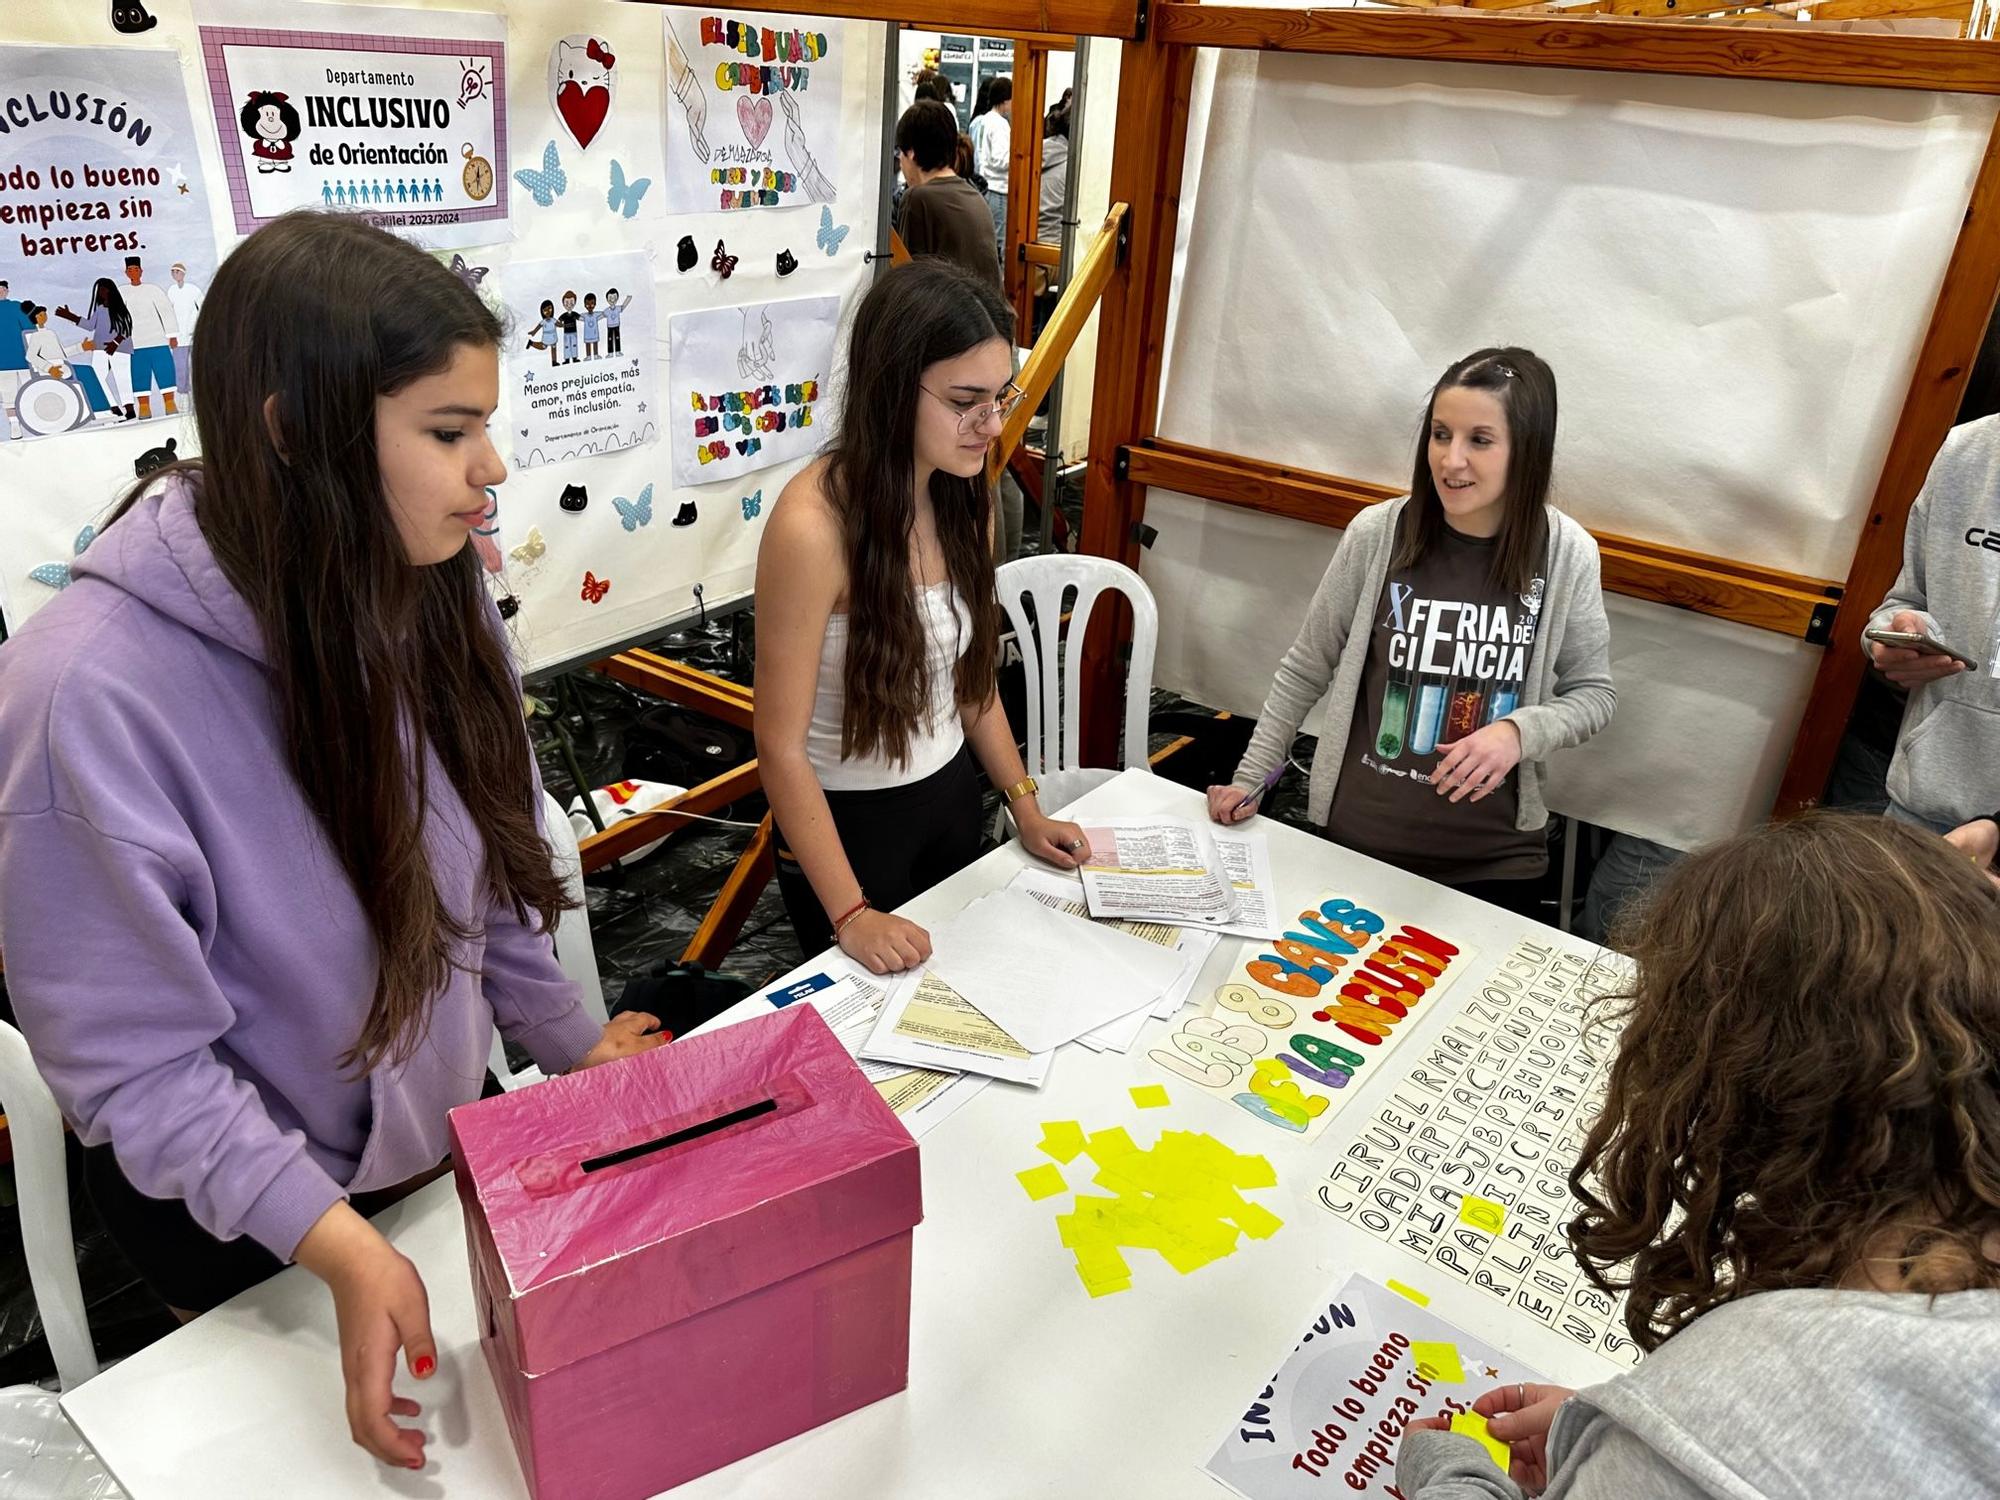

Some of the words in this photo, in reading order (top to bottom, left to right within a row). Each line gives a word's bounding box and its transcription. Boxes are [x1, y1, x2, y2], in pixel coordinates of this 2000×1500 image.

[700, 16, 726, 46] EL
[326, 68, 415, 87] Departamento
[305, 96, 450, 129] INCLUSIVO
[310, 143, 335, 165] de
[338, 141, 448, 165] Orientación
[51, 165, 75, 189] lo
[83, 163, 161, 188] bueno
[0, 199, 111, 231] empieza
[119, 196, 152, 219] sin
[409, 212, 460, 226] 2023/2024
[21, 231, 146, 257] barreras.
[523, 381, 558, 397] Menos
[561, 372, 618, 392] prejuicios,
[620, 366, 640, 380] más
[531, 396, 563, 410] amor,
[566, 390, 587, 403] más
[590, 382, 635, 399] empatía,
[548, 407, 570, 420] más
[573, 398, 622, 415] inclusión.
[1382, 581, 1414, 633] X
[1407, 598, 1510, 675] FERIA
[1389, 599, 1524, 681] CIENCIA
[1246, 898, 1385, 998] CLAVES
[1214, 983, 1297, 1029] 8
[1147, 1016, 1268, 1088] LAS
[1275, 1033, 1365, 1089] LA
[1292, 1422, 1347, 1477] Todo
[1332, 1397, 1365, 1422] lo
[1349, 1332, 1411, 1396] bueno
[1344, 1395, 1419, 1491] empieza
[1406, 1360, 1440, 1397] sin
